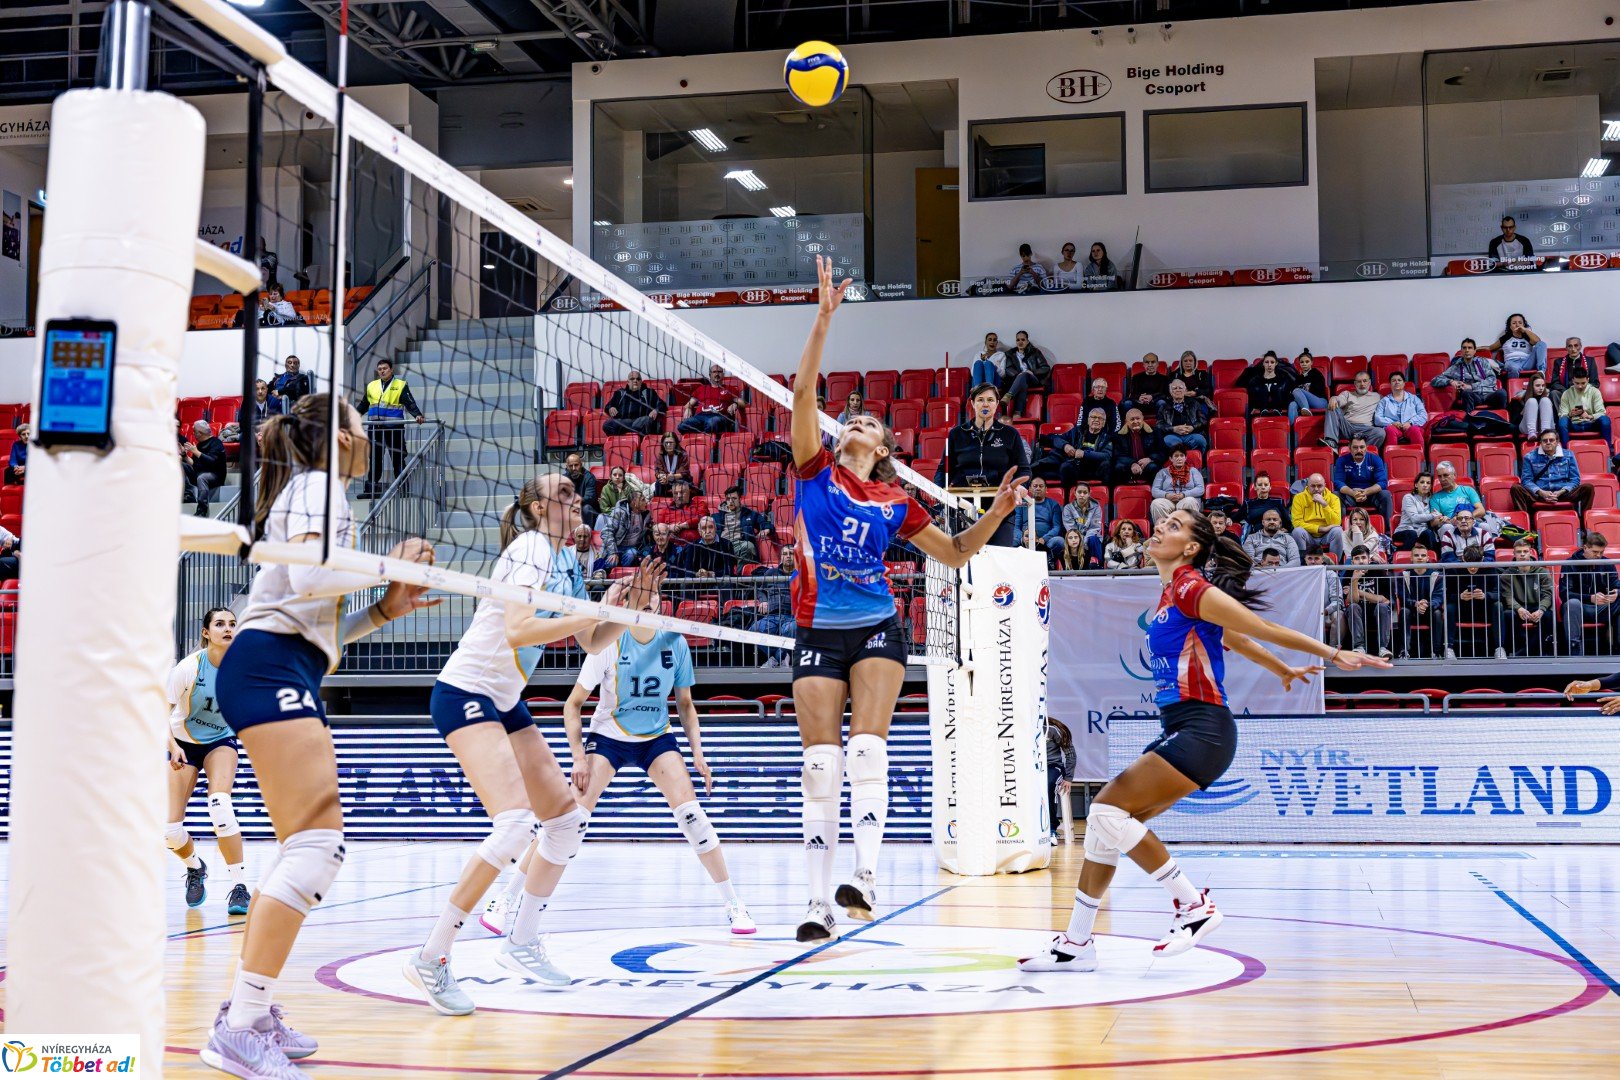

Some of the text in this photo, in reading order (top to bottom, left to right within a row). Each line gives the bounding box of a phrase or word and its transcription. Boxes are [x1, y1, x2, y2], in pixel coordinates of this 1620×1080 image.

[1126, 63, 1225, 80] Bige Holding
[1059, 75, 1099, 98] BH
[1145, 81, 1206, 96] Csoport
[1580, 254, 1602, 266] BH
[788, 287, 813, 295] Holding
[887, 282, 912, 290] Holding
[746, 290, 766, 302] BH
[842, 516, 871, 549] 21
[800, 650, 822, 667] 21
[629, 675, 661, 698] 12
[276, 686, 317, 713] 24
[463, 700, 485, 721] 2
[1259, 744, 1365, 766] NYÍR-
[1260, 765, 1613, 816] WETLAND
